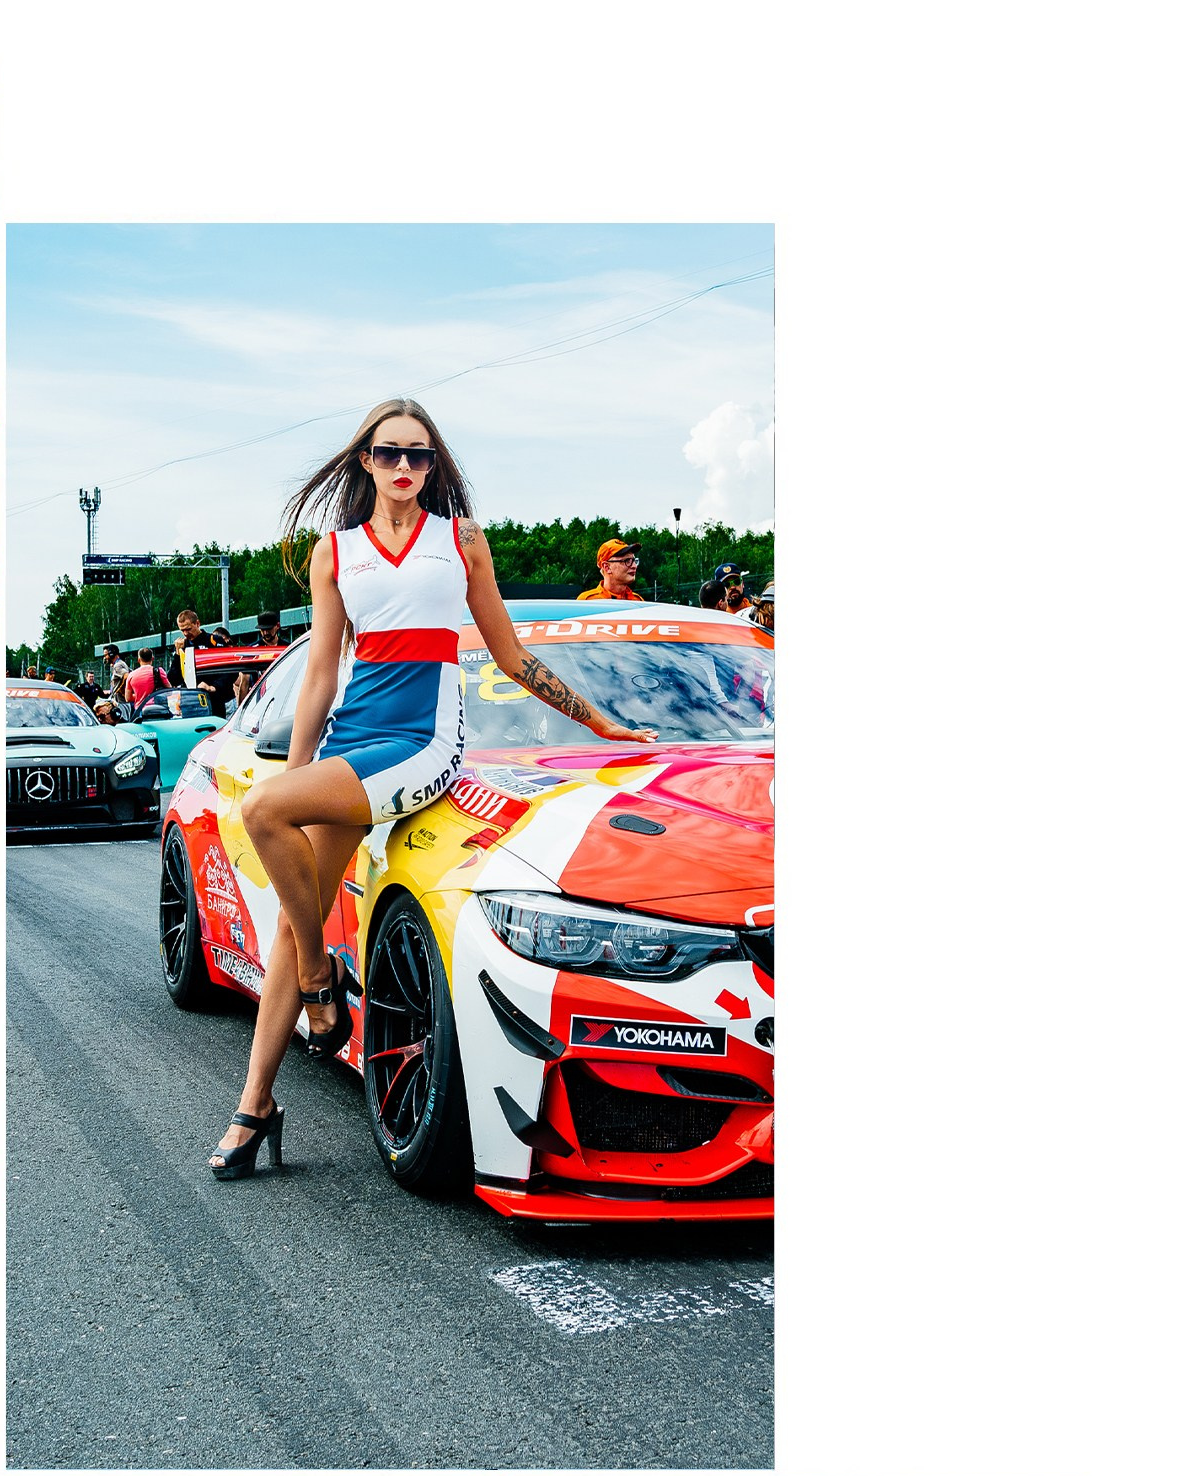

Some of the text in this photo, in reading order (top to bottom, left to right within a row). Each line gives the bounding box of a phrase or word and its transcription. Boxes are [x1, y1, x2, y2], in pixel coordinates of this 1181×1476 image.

[6, 690, 39, 698] RIVE
[411, 769, 451, 807] SMP
[614, 1026, 715, 1049] YOKOHAMA
